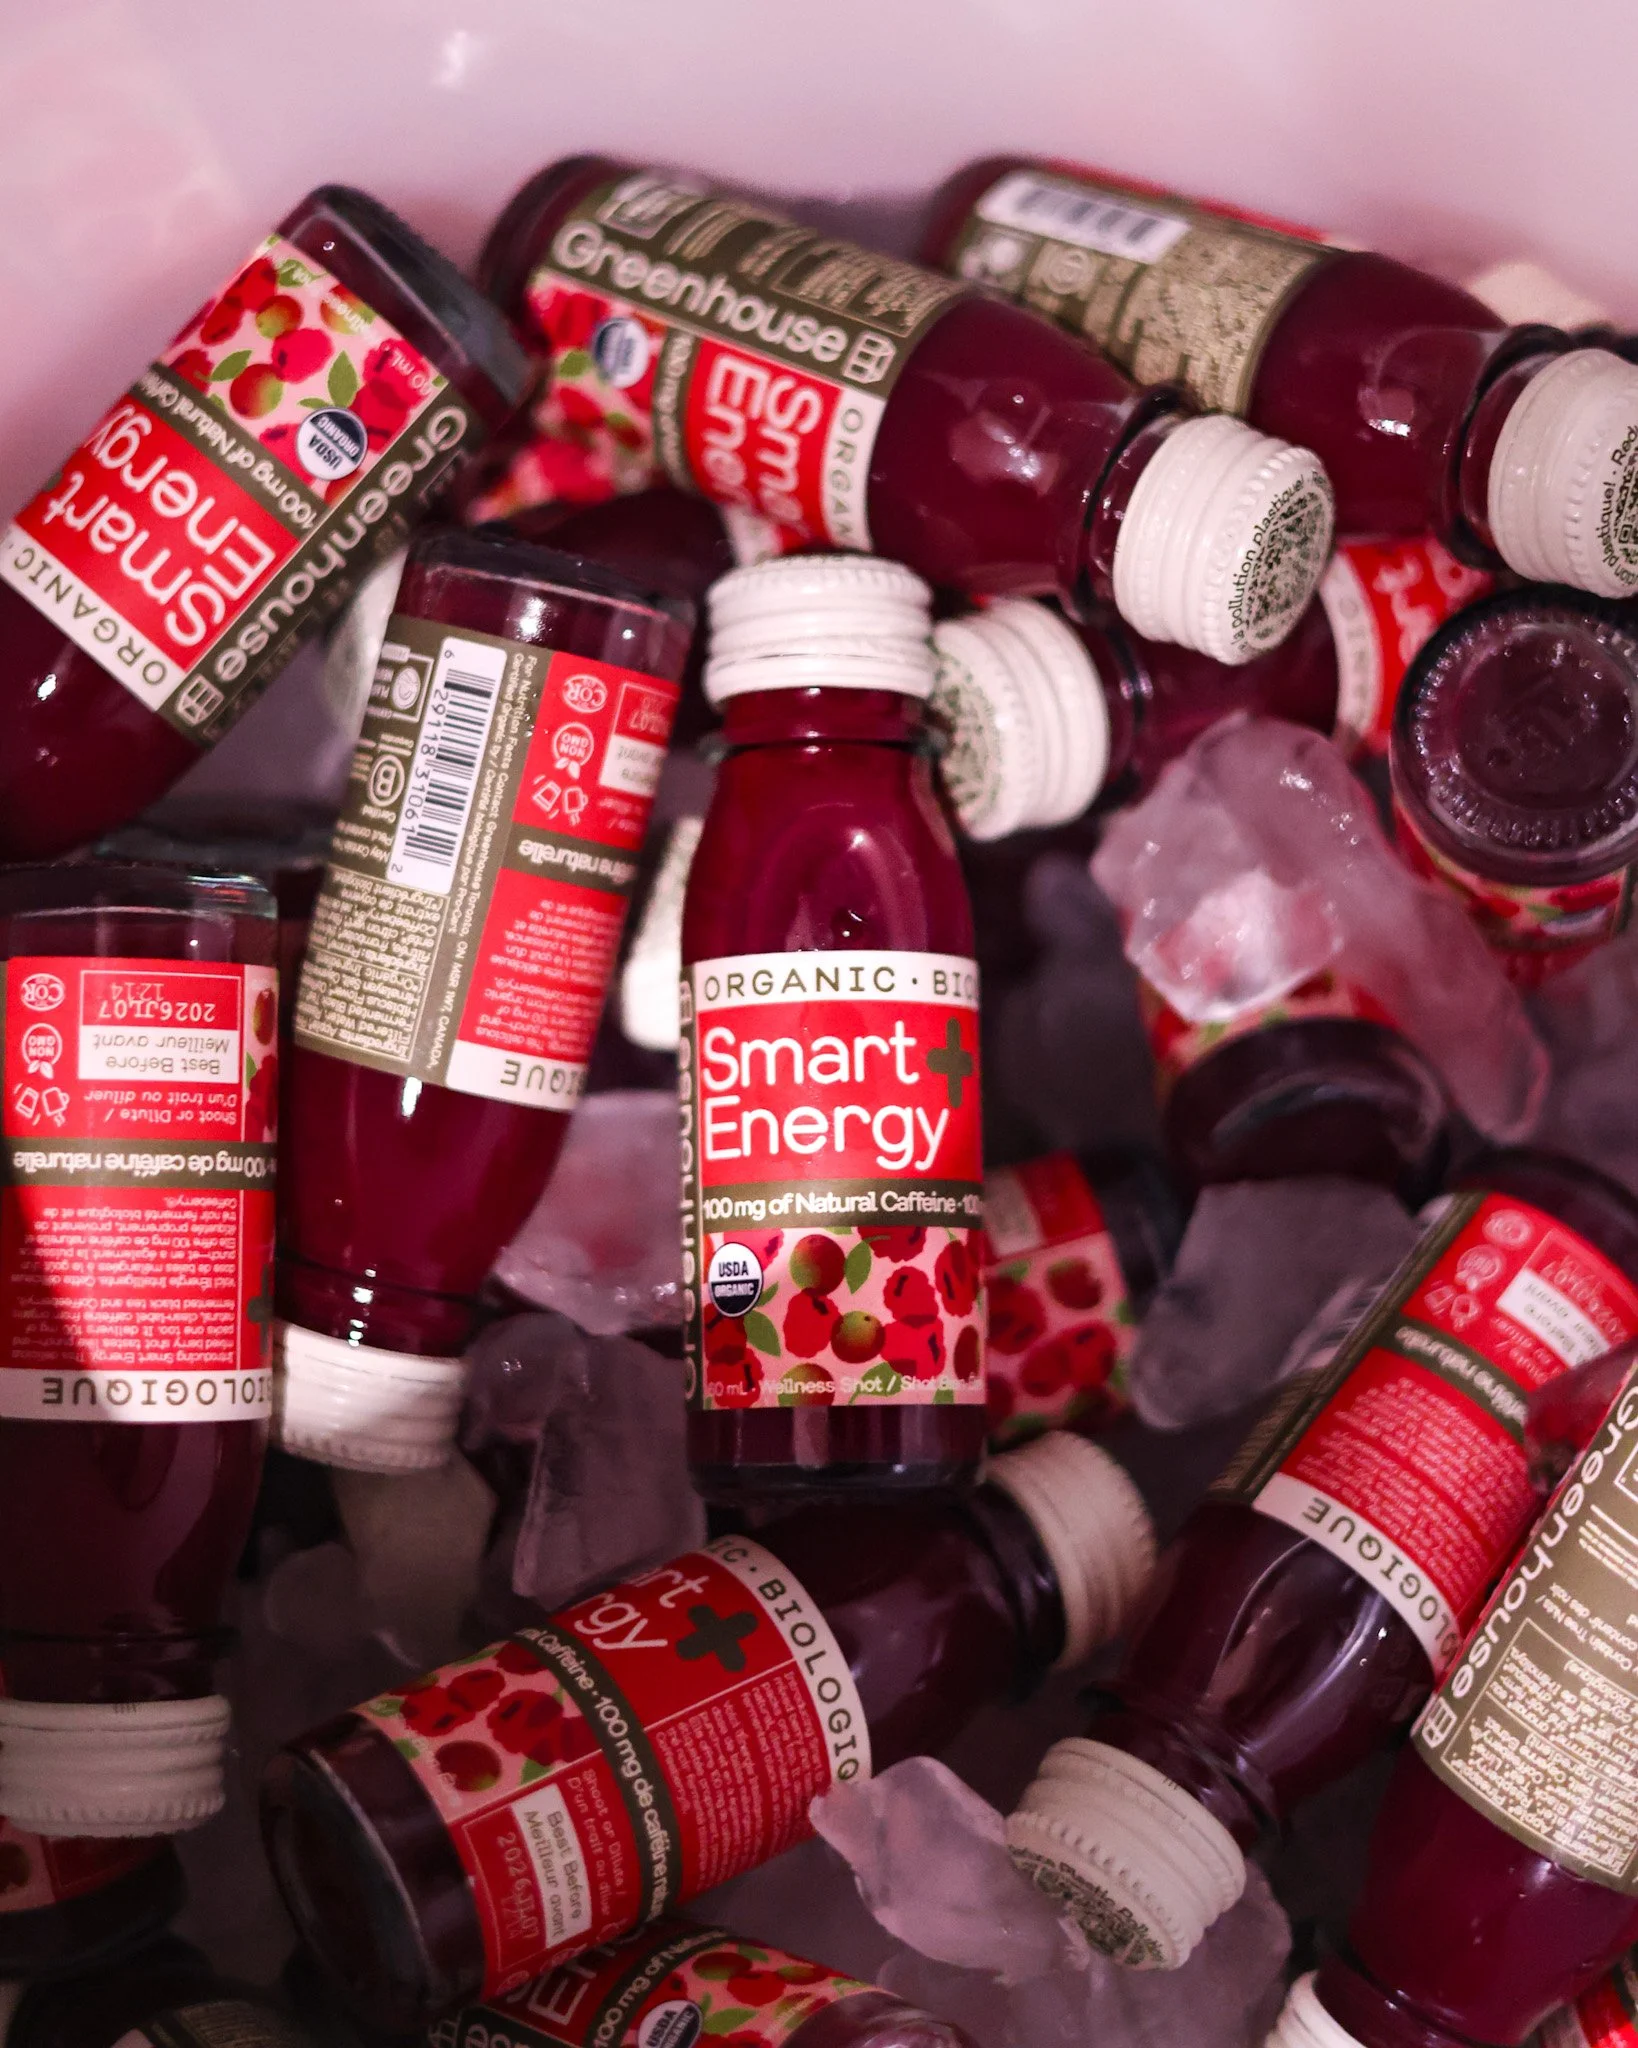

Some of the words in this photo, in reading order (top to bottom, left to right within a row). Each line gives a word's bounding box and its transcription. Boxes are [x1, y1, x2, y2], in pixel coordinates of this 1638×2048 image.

[553, 222, 846, 362] Greenhouse
[171, 394, 238, 457] Natural
[314, 413, 362, 458] ORGANIC
[224, 441, 259, 476] of
[305, 432, 344, 470] USDA
[247, 456, 292, 500] mg
[830, 408, 866, 537] ORGAN
[83, 403, 277, 601] Energy
[275, 486, 323, 532] 100
[1597, 481, 1620, 567] plastique!
[42, 469, 228, 649] Smart
[214, 405, 470, 682] Greenhouse
[1231, 550, 1255, 628] pollution
[1254, 474, 1304, 546] plastique!
[12, 543, 172, 689] ORGANIC
[441, 648, 454, 660] 6
[520, 654, 537, 677] For
[501, 651, 525, 702] Certified
[418, 687, 450, 758] 29118
[506, 678, 532, 734] Nutrition
[485, 743, 502, 760] by
[498, 735, 518, 770] Facts
[558, 743, 586, 758] NON
[559, 731, 589, 747] GMO
[398, 765, 430, 838] 31061
[486, 770, 509, 819] Contact
[388, 861, 403, 875] 2
[469, 819, 496, 890] Greenhouse
[456, 866, 471, 887] par
[455, 888, 480, 939] Toronto,
[452, 940, 468, 961] ON
[704, 966, 895, 1001] ORGANIC
[97, 997, 216, 1021] 2026JL07
[27, 1033, 55, 1045] GMO
[27, 1044, 55, 1057] NON
[90, 1033, 148, 1048] avant
[152, 1034, 230, 1053] Meilleur
[425, 1013, 450, 1071] CANADA,
[702, 1020, 919, 1091] Smart
[103, 1054, 174, 1073] Before
[180, 1057, 220, 1074] Best
[82, 1088, 135, 1105] diluer
[139, 1090, 162, 1101] ou
[167, 1091, 203, 1106] trait
[208, 1092, 237, 1107] D'un
[118, 1107, 171, 1123] Dilute
[176, 1108, 192, 1120] or
[198, 1109, 237, 1124] Shoot
[704, 1094, 949, 1171] Energy
[12, 1150, 102, 1173] naturelle
[103, 1152, 185, 1177] caféine
[187, 1154, 214, 1175] de
[215, 1150, 243, 1171] mg
[243, 1156, 266, 1177] 100
[703, 1197, 733, 1219] 100
[735, 1199, 765, 1221] mg
[769, 1194, 793, 1216] of
[795, 1192, 878, 1213] Natural
[880, 1190, 956, 1214] Caffeine
[718, 1261, 749, 1278] USDA
[86, 1323, 138, 1336] delivers
[101, 1337, 141, 1349] tastes
[142, 1325, 154, 1336] It
[144, 1338, 170, 1349] shot
[184, 1325, 204, 1335] one
[138, 1351, 173, 1363] Smart
[841, 1377, 882, 1395] Shot
[1450, 1387, 1638, 1698] Greenhouse
[1301, 1496, 1460, 1660] OLOGIQUE
[1566, 1597, 1591, 1620] des
[1561, 1615, 1590, 1641] Tree
[1586, 1612, 1637, 1652] contenir
[538, 1630, 595, 1693] Caffeine
[1586, 1633, 1634, 1671] Contain
[759, 1576, 860, 1782] BIOLOGIQ
[591, 1691, 630, 1740] 100
[609, 1736, 647, 1781] mg
[582, 1767, 610, 1817] Shoot
[601, 1819, 616, 1839] or
[627, 1773, 661, 1811] de
[566, 1775, 590, 1814] D'un
[583, 1817, 604, 1856] trait
[644, 1808, 672, 1878] caféine
[524, 1809, 560, 1890] Meilleur
[548, 1893, 566, 1937] avant
[547, 1810, 573, 1859] Best
[561, 1860, 584, 1919] Before
[618, 1975, 651, 2006] mg
